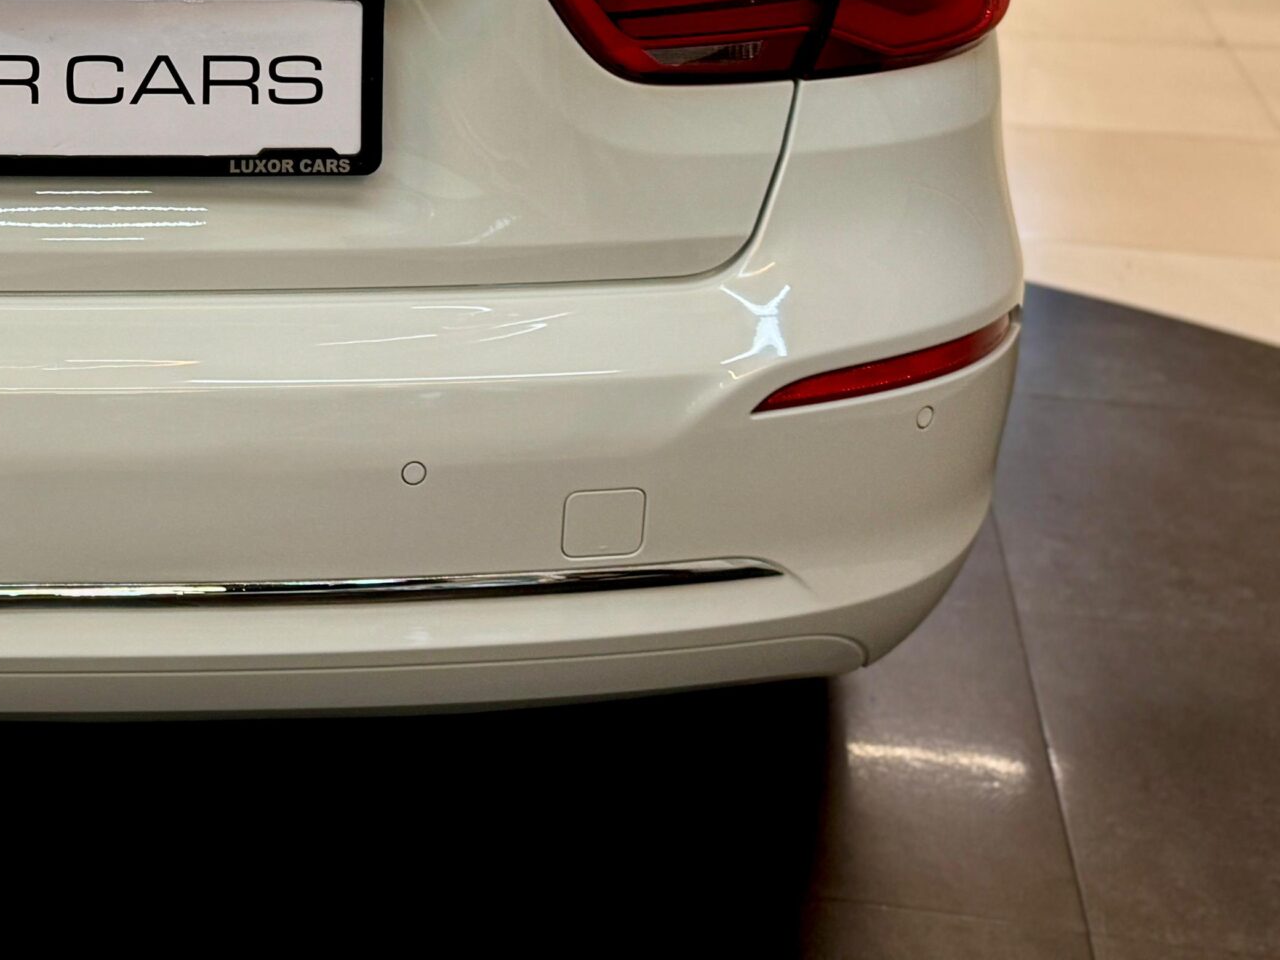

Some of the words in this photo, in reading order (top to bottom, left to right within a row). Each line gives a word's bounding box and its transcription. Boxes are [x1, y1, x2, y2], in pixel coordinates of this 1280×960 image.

[65, 54, 324, 105] CARS
[229, 159, 294, 173] LUXOR
[299, 158, 351, 173] CARS
